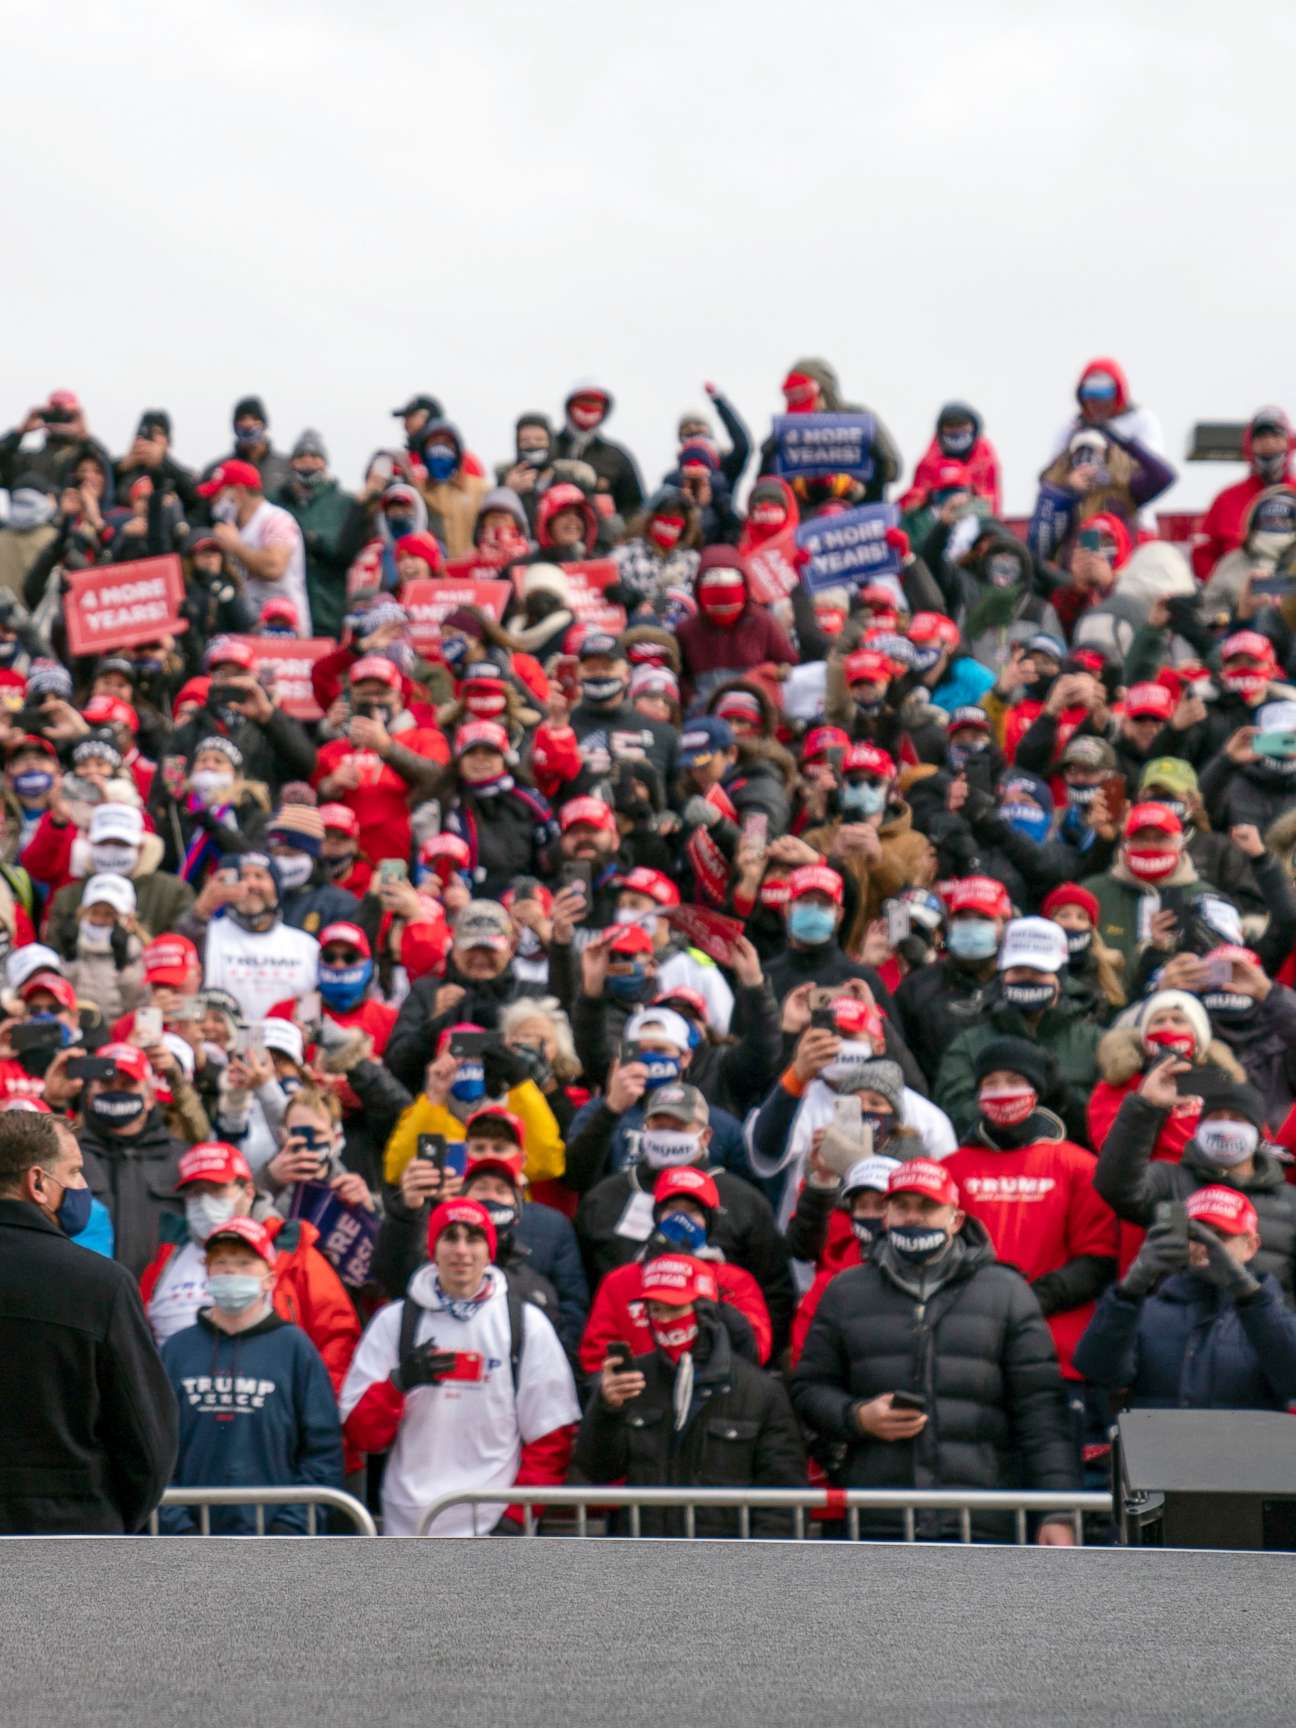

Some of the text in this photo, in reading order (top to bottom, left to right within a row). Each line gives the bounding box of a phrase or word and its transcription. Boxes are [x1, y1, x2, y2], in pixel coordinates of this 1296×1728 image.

[785, 426, 864, 444] 4 MORE
[785, 445, 862, 464] YEARS!
[806, 518, 886, 551] 4 MORE
[812, 542, 888, 575] YEARS!
[79, 577, 168, 610] 4 MORE
[85, 601, 169, 632] YEARS!
[225, 954, 303, 969] TRUMP
[1007, 985, 1055, 1003] TRUMP
[91, 1098, 144, 1117] TRUMP
[965, 1176, 1055, 1195] TRUMP
[890, 1227, 947, 1250] TRUMP
[655, 1324, 699, 1346] AGA
[182, 1376, 276, 1396] TRUMP
[188, 1393, 265, 1408] PENCE
